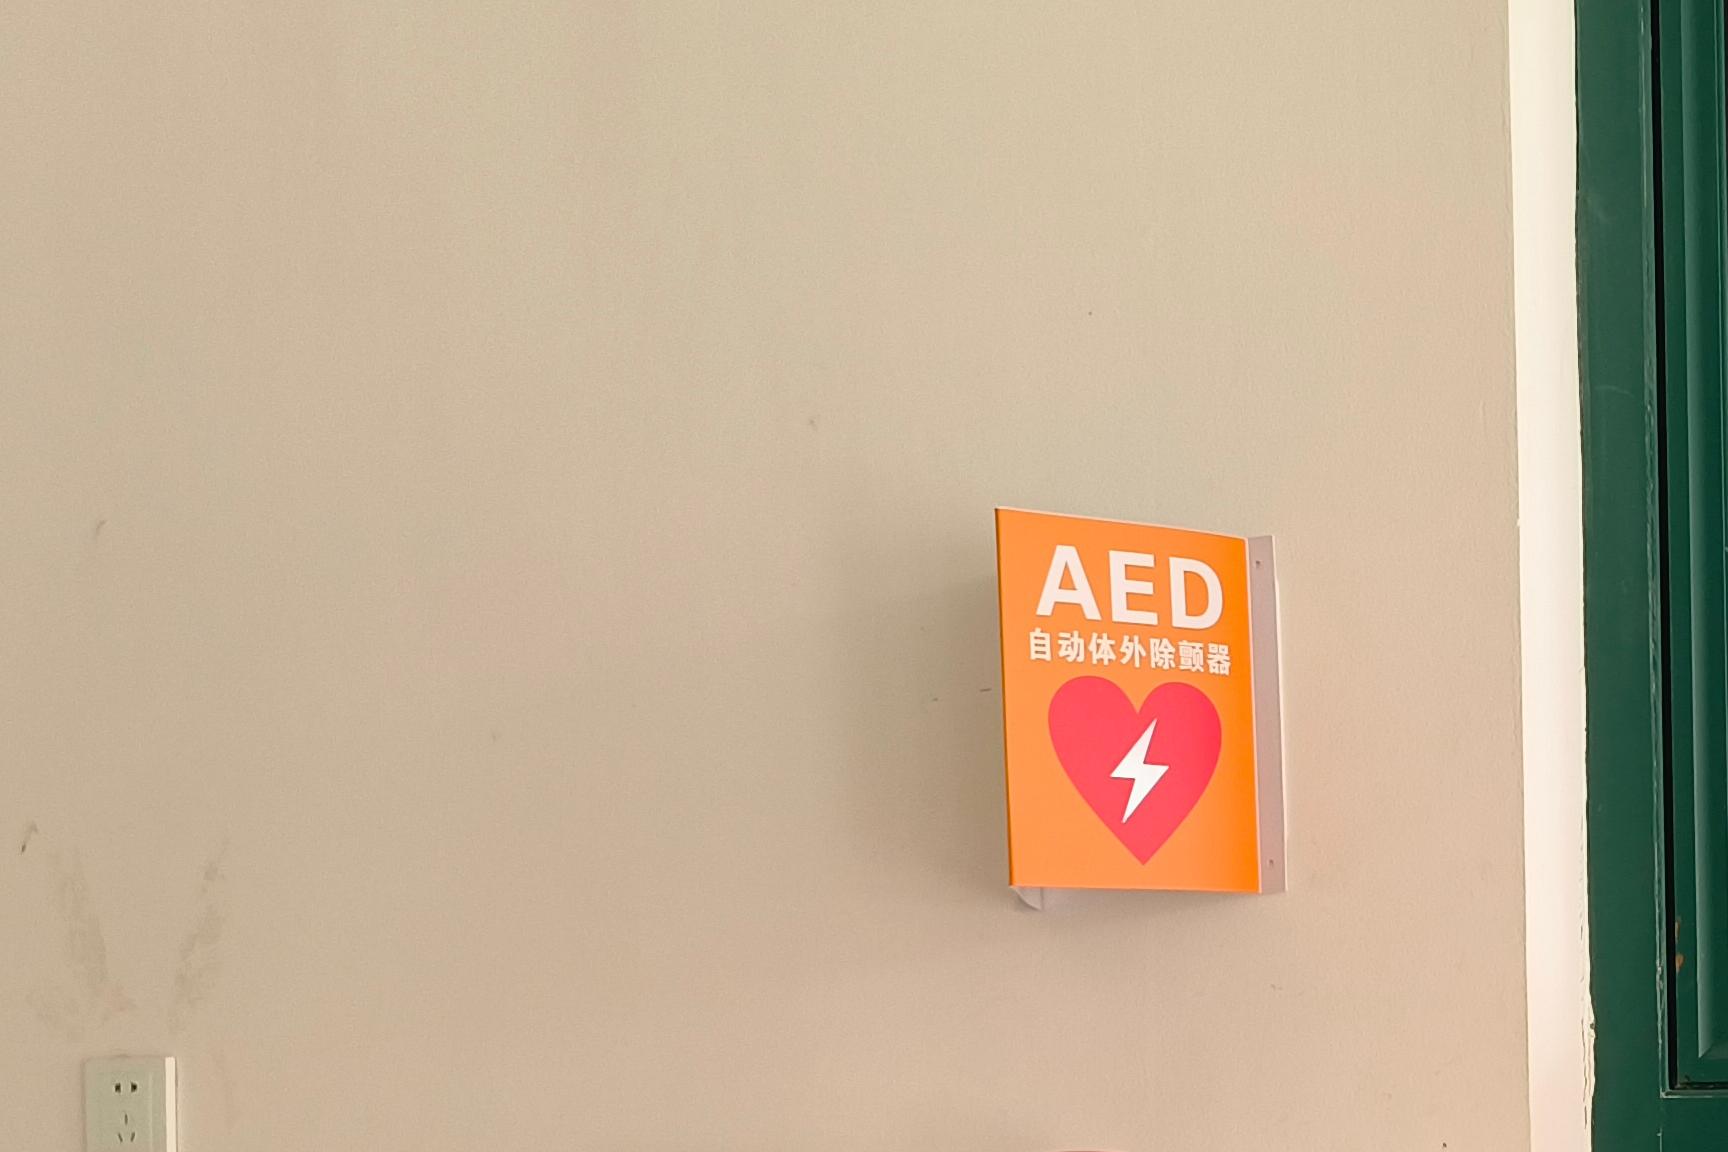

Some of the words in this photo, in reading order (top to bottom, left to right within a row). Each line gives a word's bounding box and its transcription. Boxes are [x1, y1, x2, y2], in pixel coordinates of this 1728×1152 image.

[1035, 545, 1223, 629] AED
[1028, 627, 1232, 676] 自动体外除颤器
